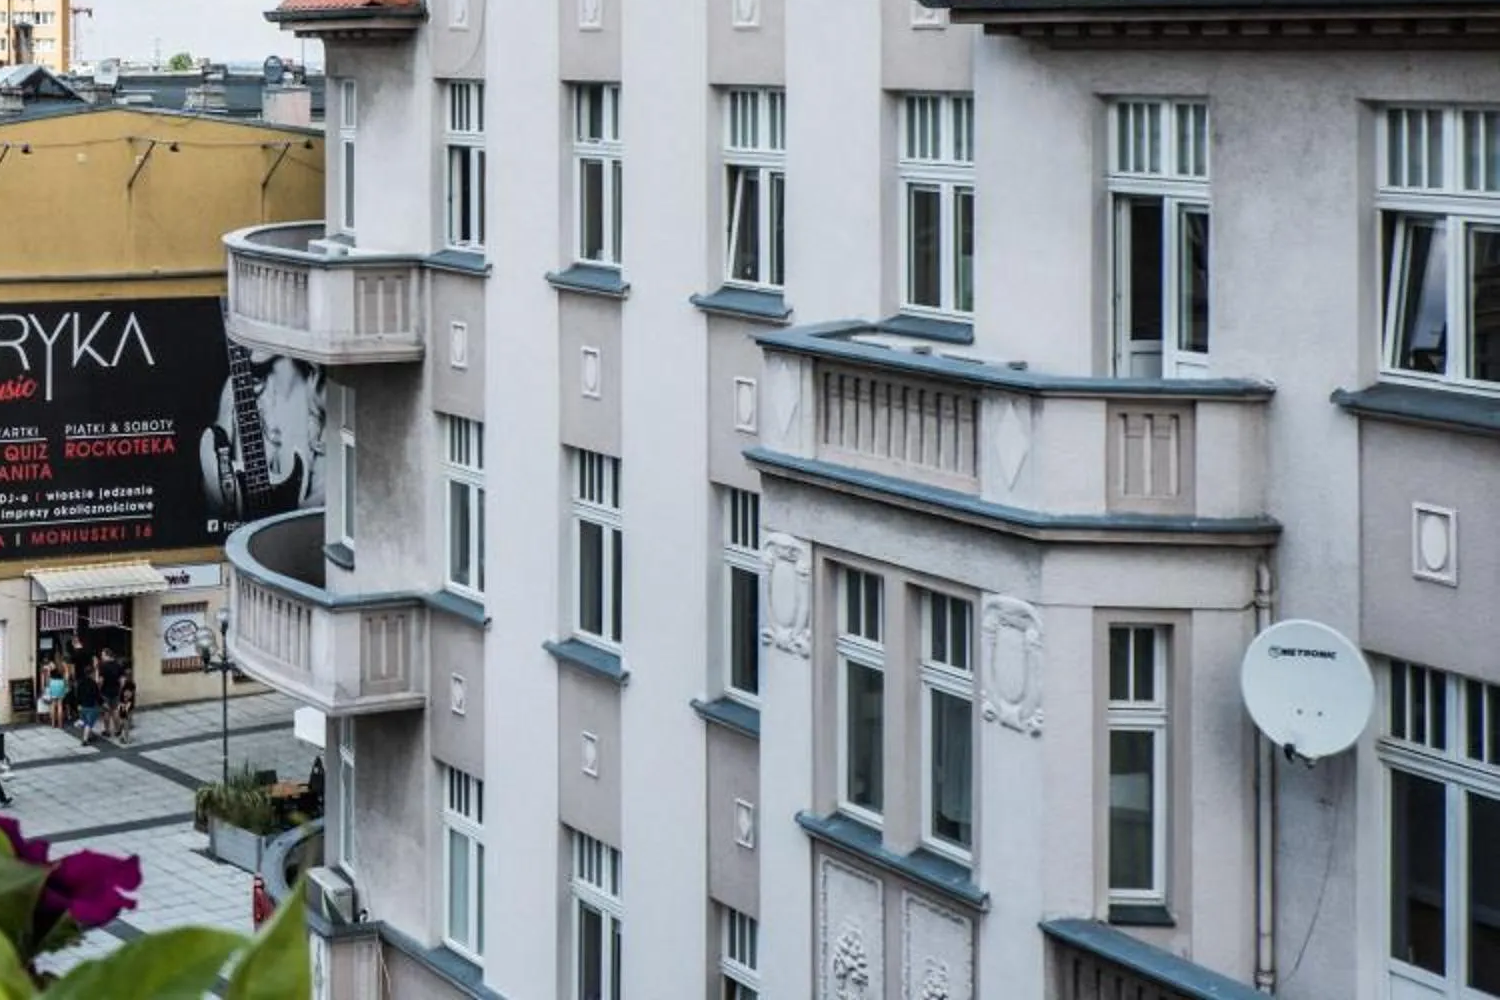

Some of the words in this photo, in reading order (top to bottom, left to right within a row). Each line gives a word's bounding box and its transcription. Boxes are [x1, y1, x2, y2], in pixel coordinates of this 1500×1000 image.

[124, 419, 173, 432] SOBOTY
[4, 443, 49, 462] QUIZ
[65, 437, 176, 458] ROCKOTEKA
[99, 485, 154, 500] jedzenie
[1, 507, 50, 520] imprezy
[31, 524, 125, 545] MONIUSZKI
